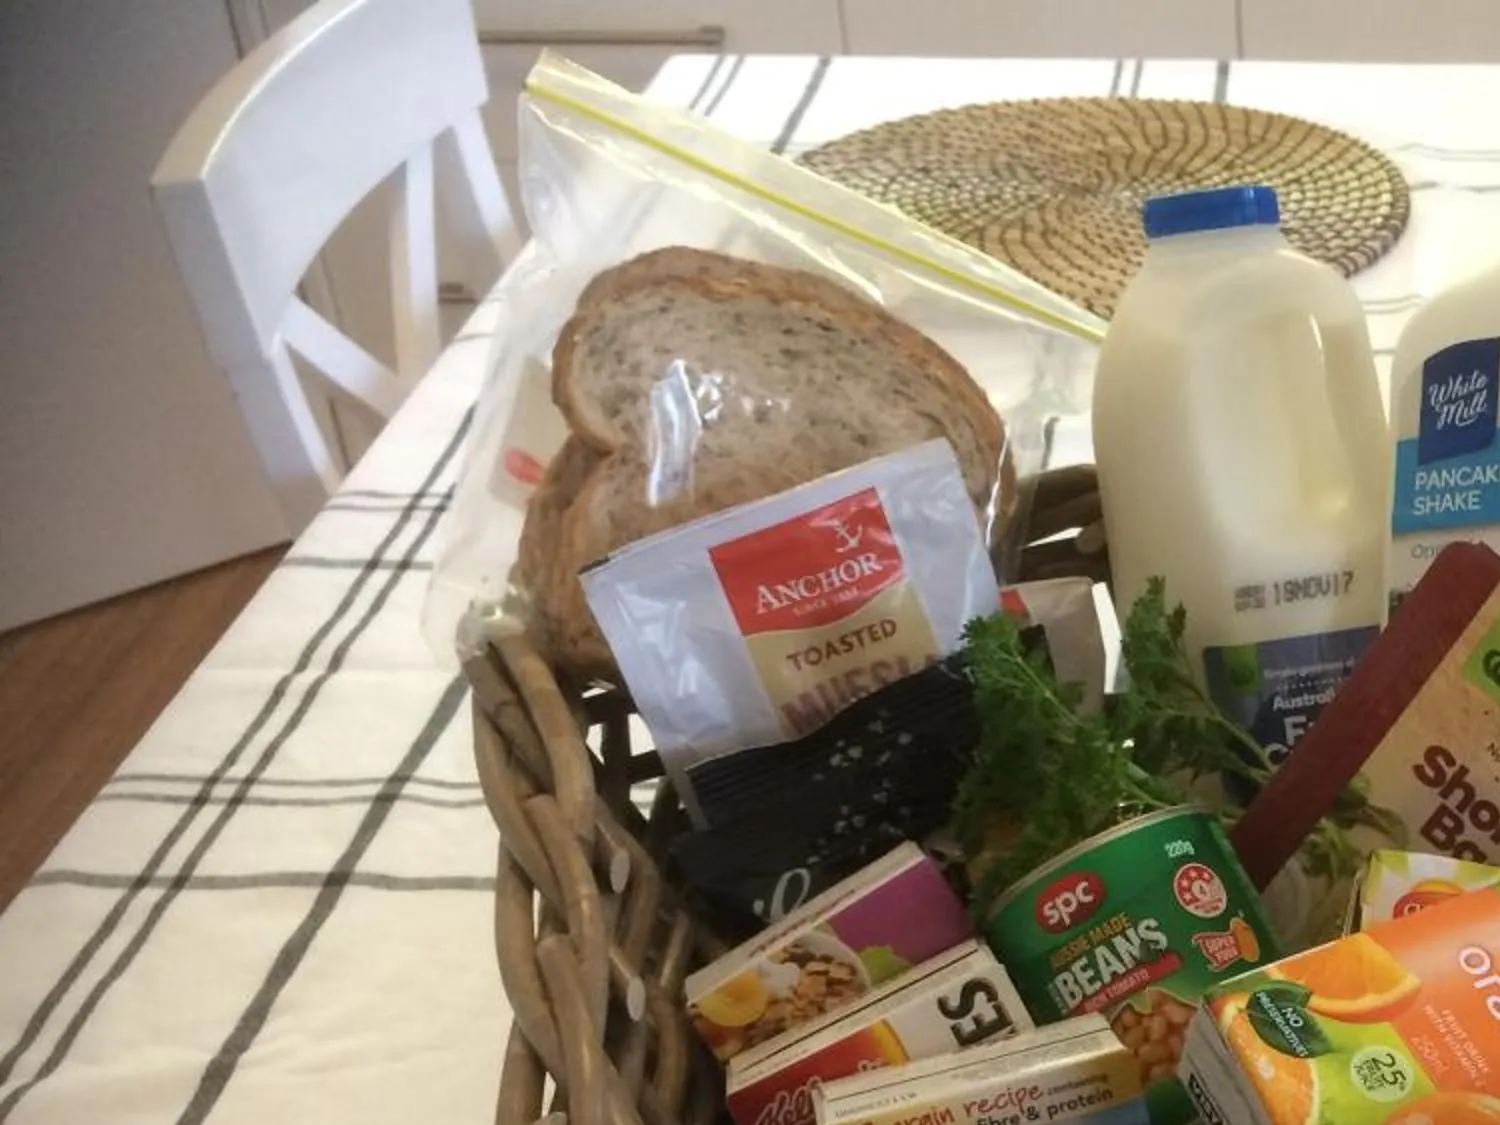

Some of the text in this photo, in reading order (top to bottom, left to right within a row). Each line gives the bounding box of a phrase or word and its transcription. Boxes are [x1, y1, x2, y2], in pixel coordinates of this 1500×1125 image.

[1429, 369, 1489, 407] White
[1412, 490, 1482, 517] SHAKE
[755, 553, 883, 615] ANCHOR
[786, 618, 898, 672] TOASTED
[1042, 880, 1097, 929] spc
[1053, 917, 1169, 1013] BEANS
[937, 977, 1014, 1047] ES
[1281, 1007, 1304, 1027] NO
[962, 1081, 1046, 1121] recipe
[1024, 1103, 1043, 1123] &
[1045, 1086, 1114, 1123] protein
